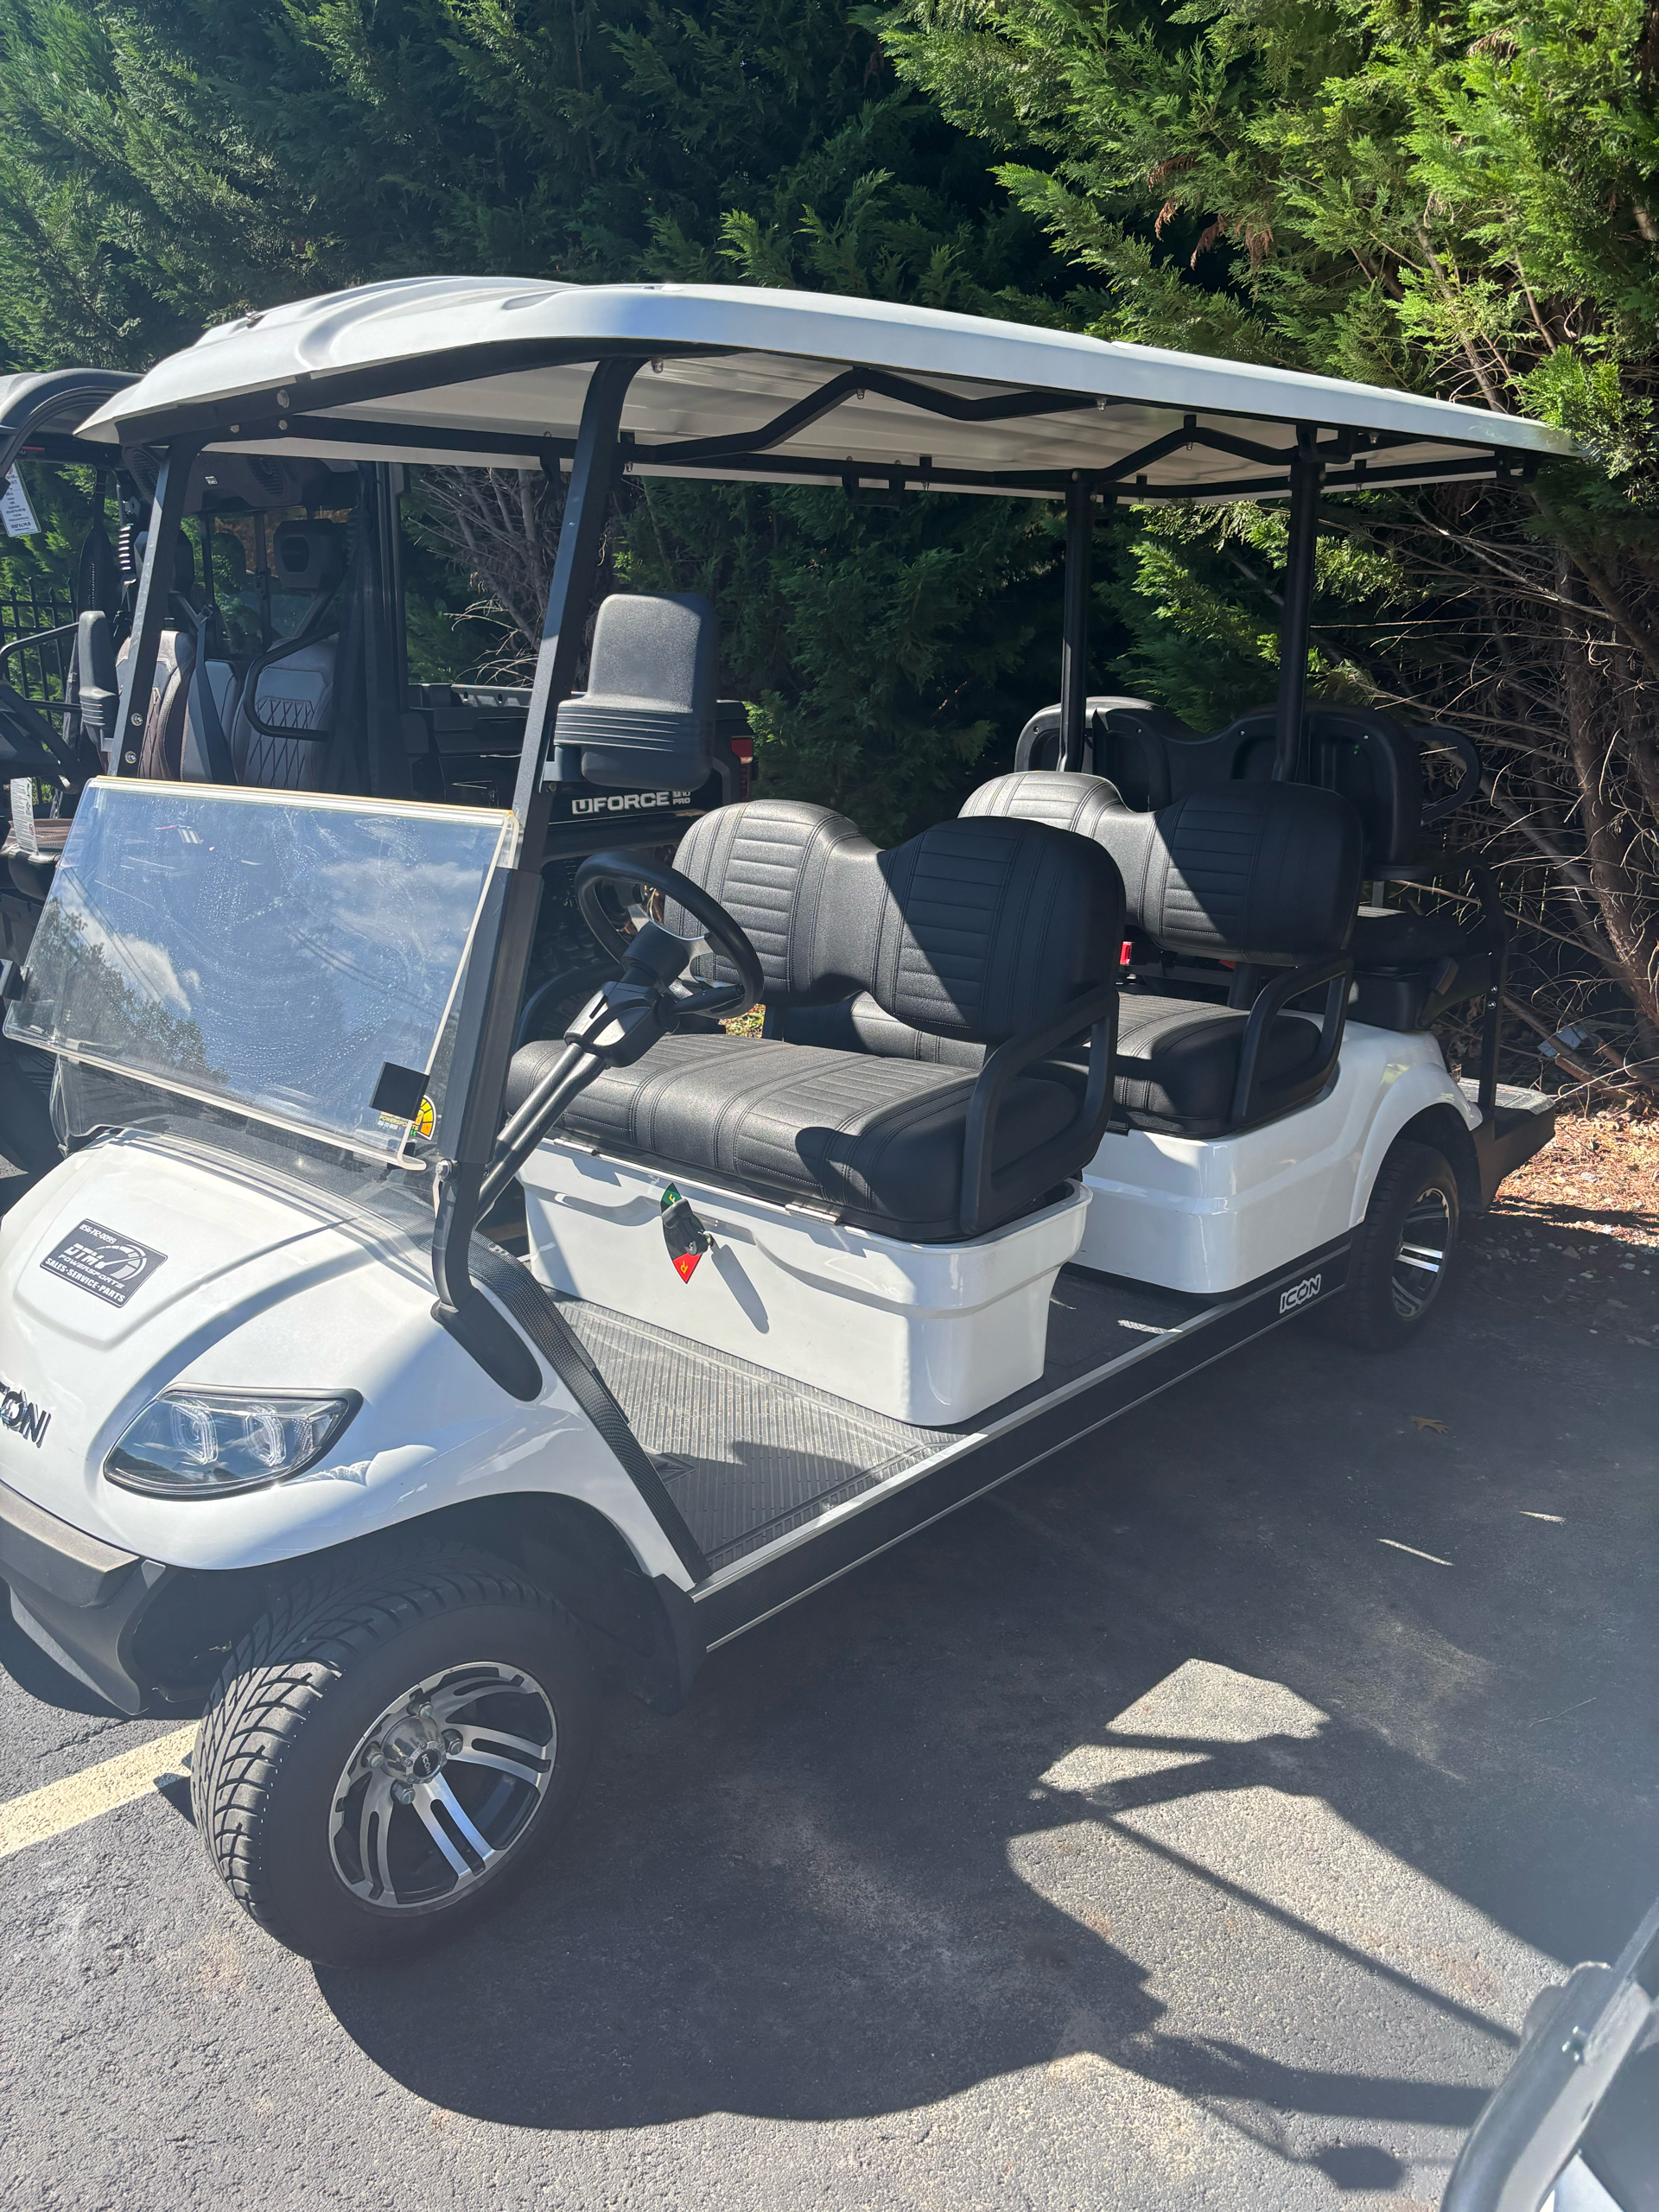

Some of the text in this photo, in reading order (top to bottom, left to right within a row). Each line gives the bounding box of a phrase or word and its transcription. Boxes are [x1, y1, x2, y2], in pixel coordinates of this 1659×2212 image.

[572, 791, 671, 815] UFORCE
[672, 797, 691, 805] PRO
[378, 1115, 419, 1131] POWERSPOTS
[58, 1254, 125, 1289] POWERSPORTS
[680, 1260, 689, 1274] R
[1280, 1273, 1322, 1314] ICON
[0, 1381, 52, 1449] ON
[422, 1753, 432, 1775] ICON
